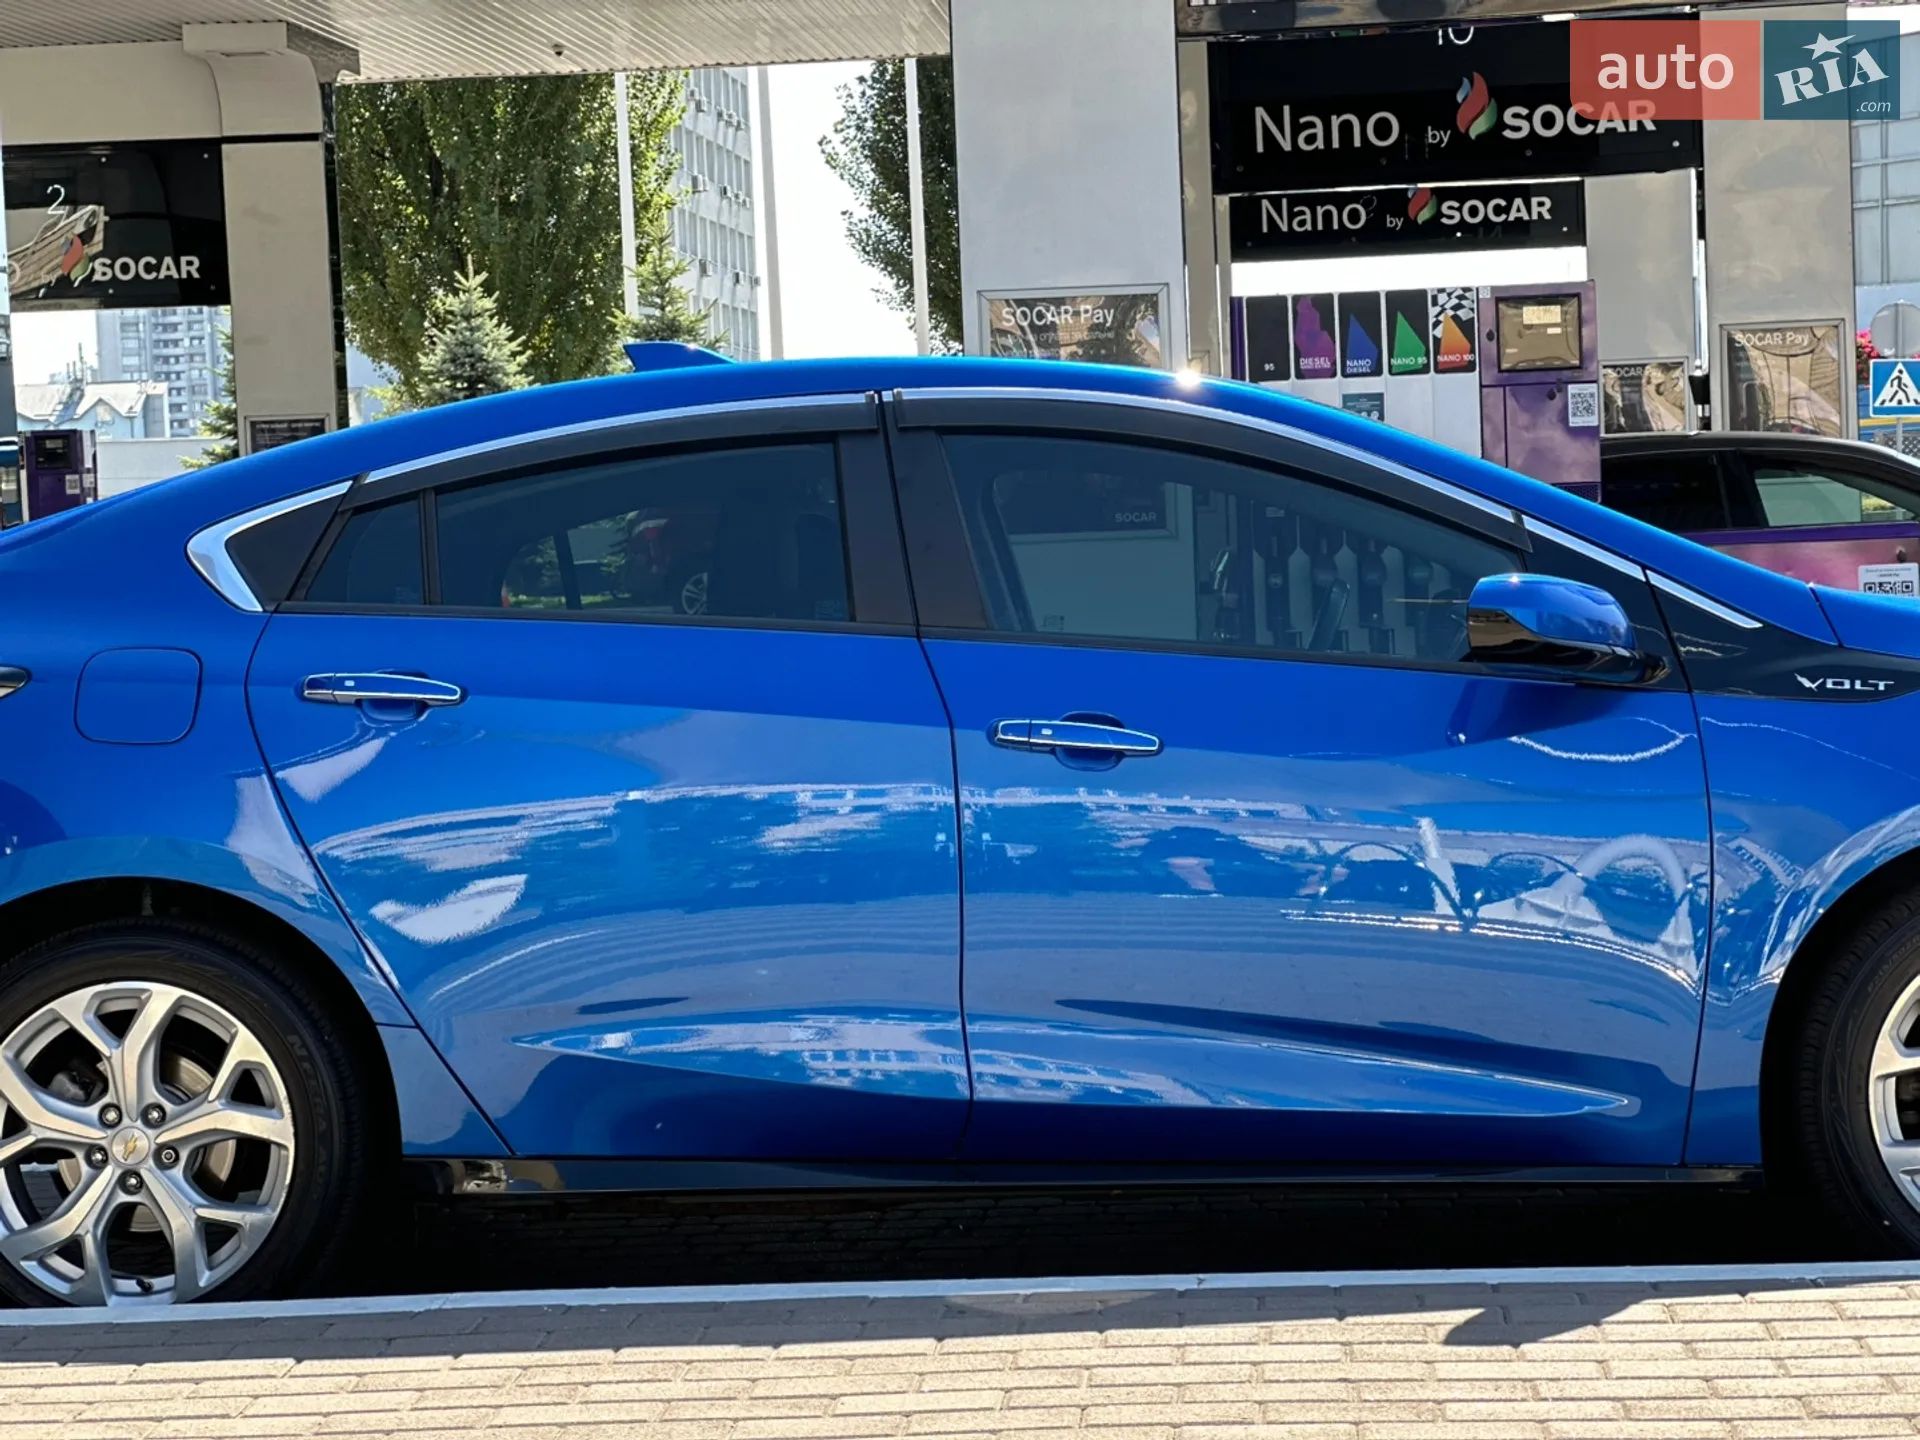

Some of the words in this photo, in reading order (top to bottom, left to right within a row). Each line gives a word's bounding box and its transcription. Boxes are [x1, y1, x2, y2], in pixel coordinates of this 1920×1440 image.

[1255, 105, 1400, 153] Nano
[1427, 126, 1451, 147] by
[1502, 100, 1657, 139] SOCAR
[46, 184, 67, 214] 2
[1261, 198, 1367, 233] Nano
[1386, 214, 1404, 230] by
[1440, 196, 1552, 225] SOCAR
[92, 255, 200, 281] SOCAR
[1002, 305, 1073, 327] SOCAR
[1080, 305, 1115, 327] Pay
[1735, 332, 1783, 347] SOCAR
[1786, 331, 1809, 346] Pay
[1264, 362, 1275, 371] 95
[1346, 359, 1371, 367] NANO
[1391, 357, 1416, 365] NANO
[1437, 354, 1461, 362] NANO
[1114, 511, 1157, 523] SOCAR
[1794, 673, 1895, 692] VOLT
